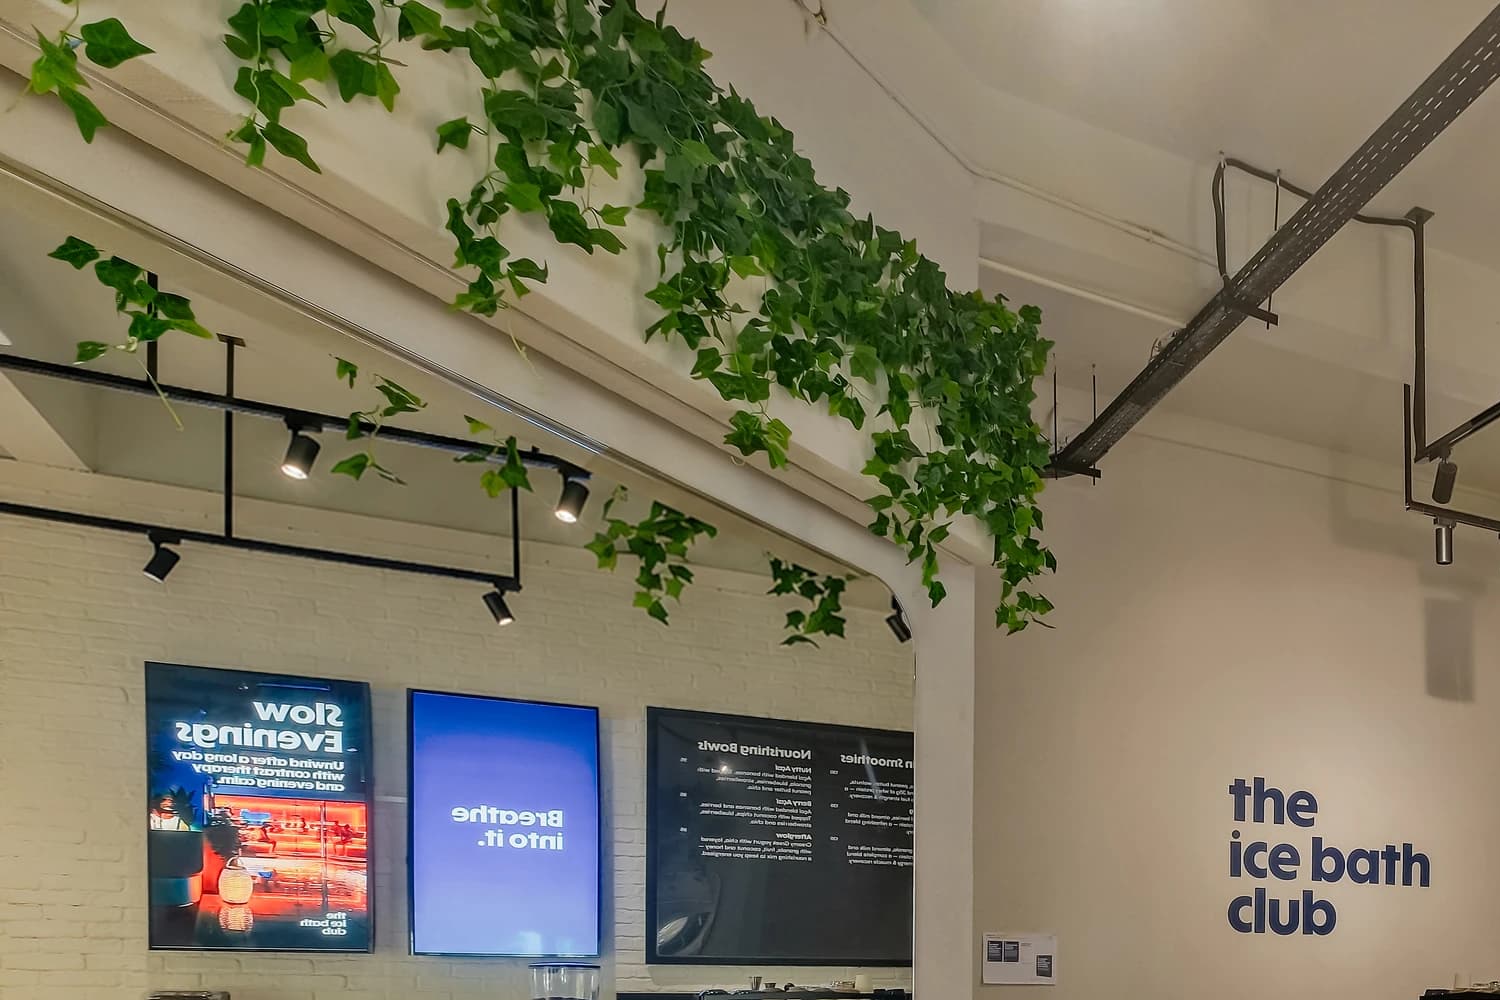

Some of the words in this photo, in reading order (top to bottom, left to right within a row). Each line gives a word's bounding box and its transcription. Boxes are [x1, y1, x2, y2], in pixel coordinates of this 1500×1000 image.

[1228, 777, 1319, 828] the
[1229, 829, 1301, 881] ice
[1311, 836, 1430, 888] bath
[1228, 887, 1337, 935] club
